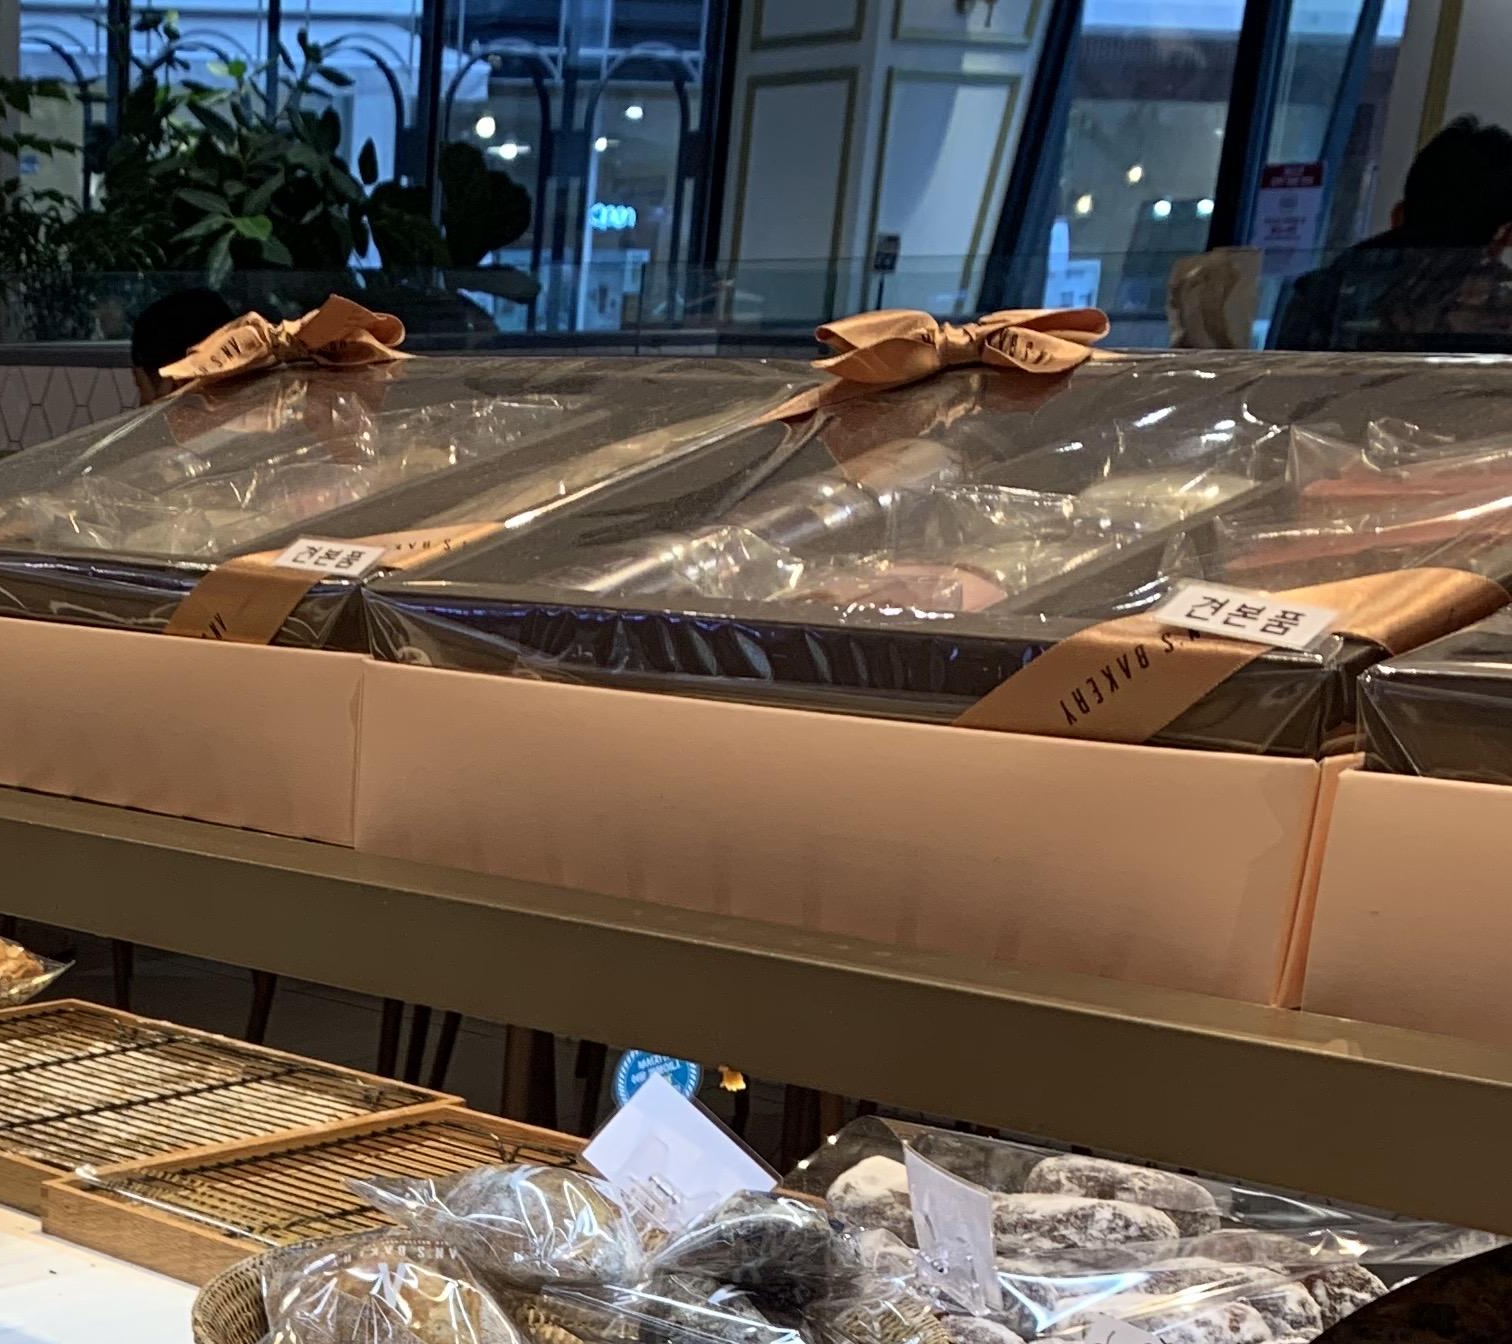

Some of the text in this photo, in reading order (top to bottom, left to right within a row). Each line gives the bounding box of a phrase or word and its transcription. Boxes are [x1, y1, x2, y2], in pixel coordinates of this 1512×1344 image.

[292, 544, 366, 569] 견본품
[1185, 595, 1307, 637] 견본품
[1059, 644, 1150, 726] BAKERY
